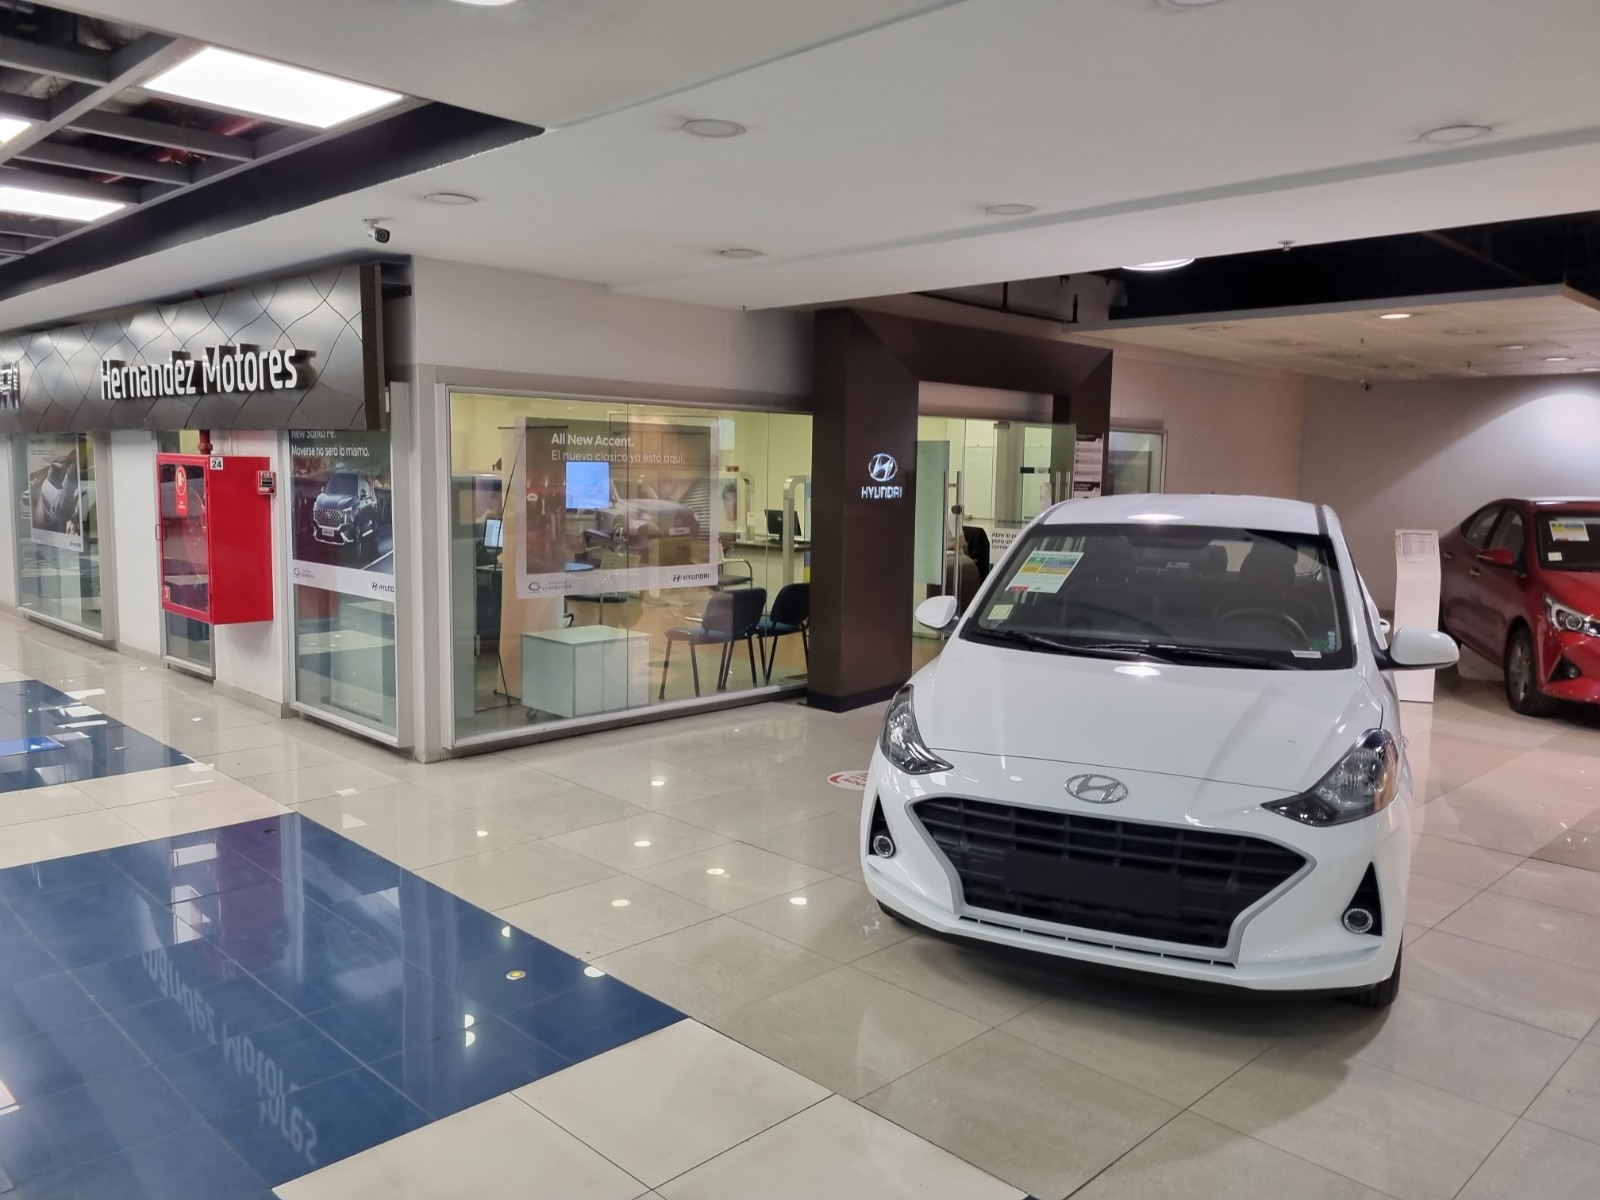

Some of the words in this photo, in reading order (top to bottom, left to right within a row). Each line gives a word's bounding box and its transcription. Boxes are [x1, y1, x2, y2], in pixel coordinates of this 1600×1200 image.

[101, 350, 196, 400] Hernandez
[202, 343, 298, 393] Motores
[551, 433, 565, 445] All
[567, 434, 593, 446] New
[594, 434, 634, 447] Accent.
[291, 445, 316, 456] Moverse
[316, 447, 324, 456] no
[338, 444, 345, 456] lo
[346, 444, 370, 456] mismo.
[551, 450, 560, 460] El
[563, 452, 593, 461] nuevo
[630, 454, 641, 464] ya
[211, 460, 222, 469] 24
[861, 486, 903, 499] HYUNDAI
[683, 573, 710, 581] HYUNDAI
